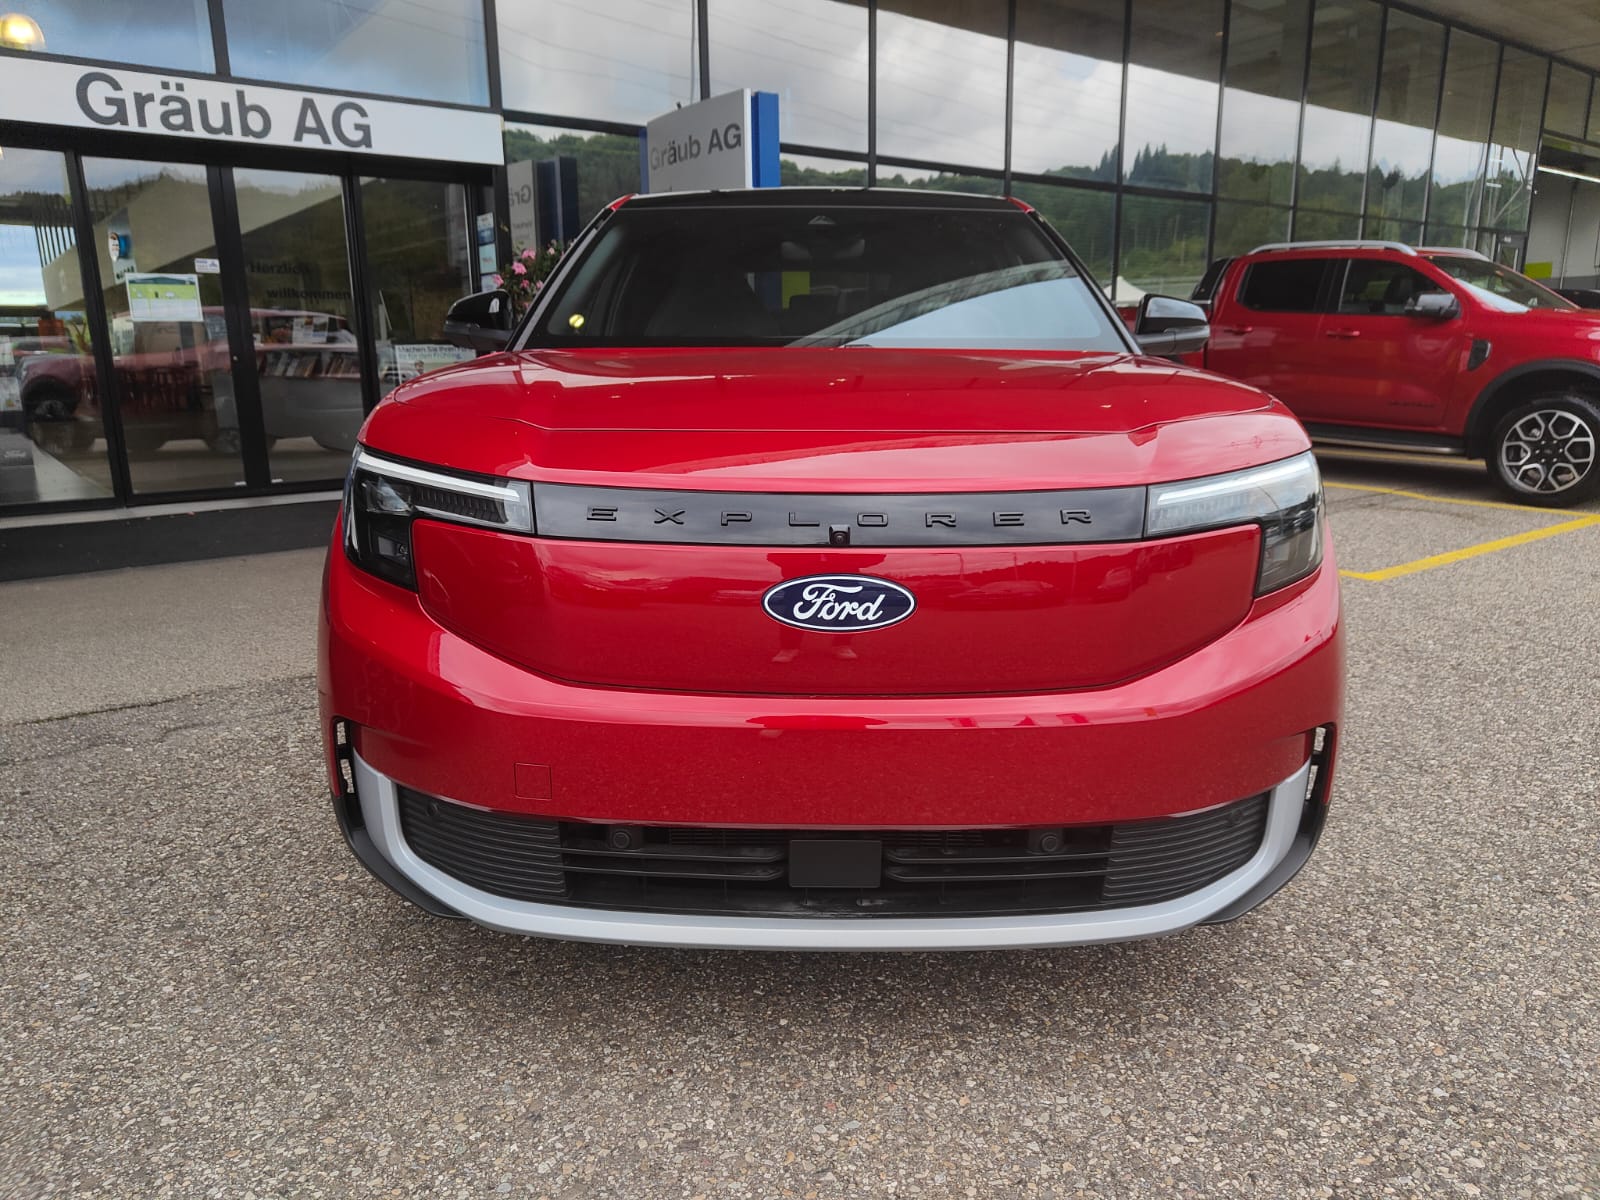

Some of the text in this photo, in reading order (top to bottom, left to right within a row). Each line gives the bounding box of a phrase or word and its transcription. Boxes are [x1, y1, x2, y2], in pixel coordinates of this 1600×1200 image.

[76, 71, 373, 149] Gräub AG
[650, 123, 742, 170] Gräub AG
[266, 288, 351, 302] willkommen
[586, 506, 1092, 528] EXPLORER
[793, 583, 886, 621] Ford
